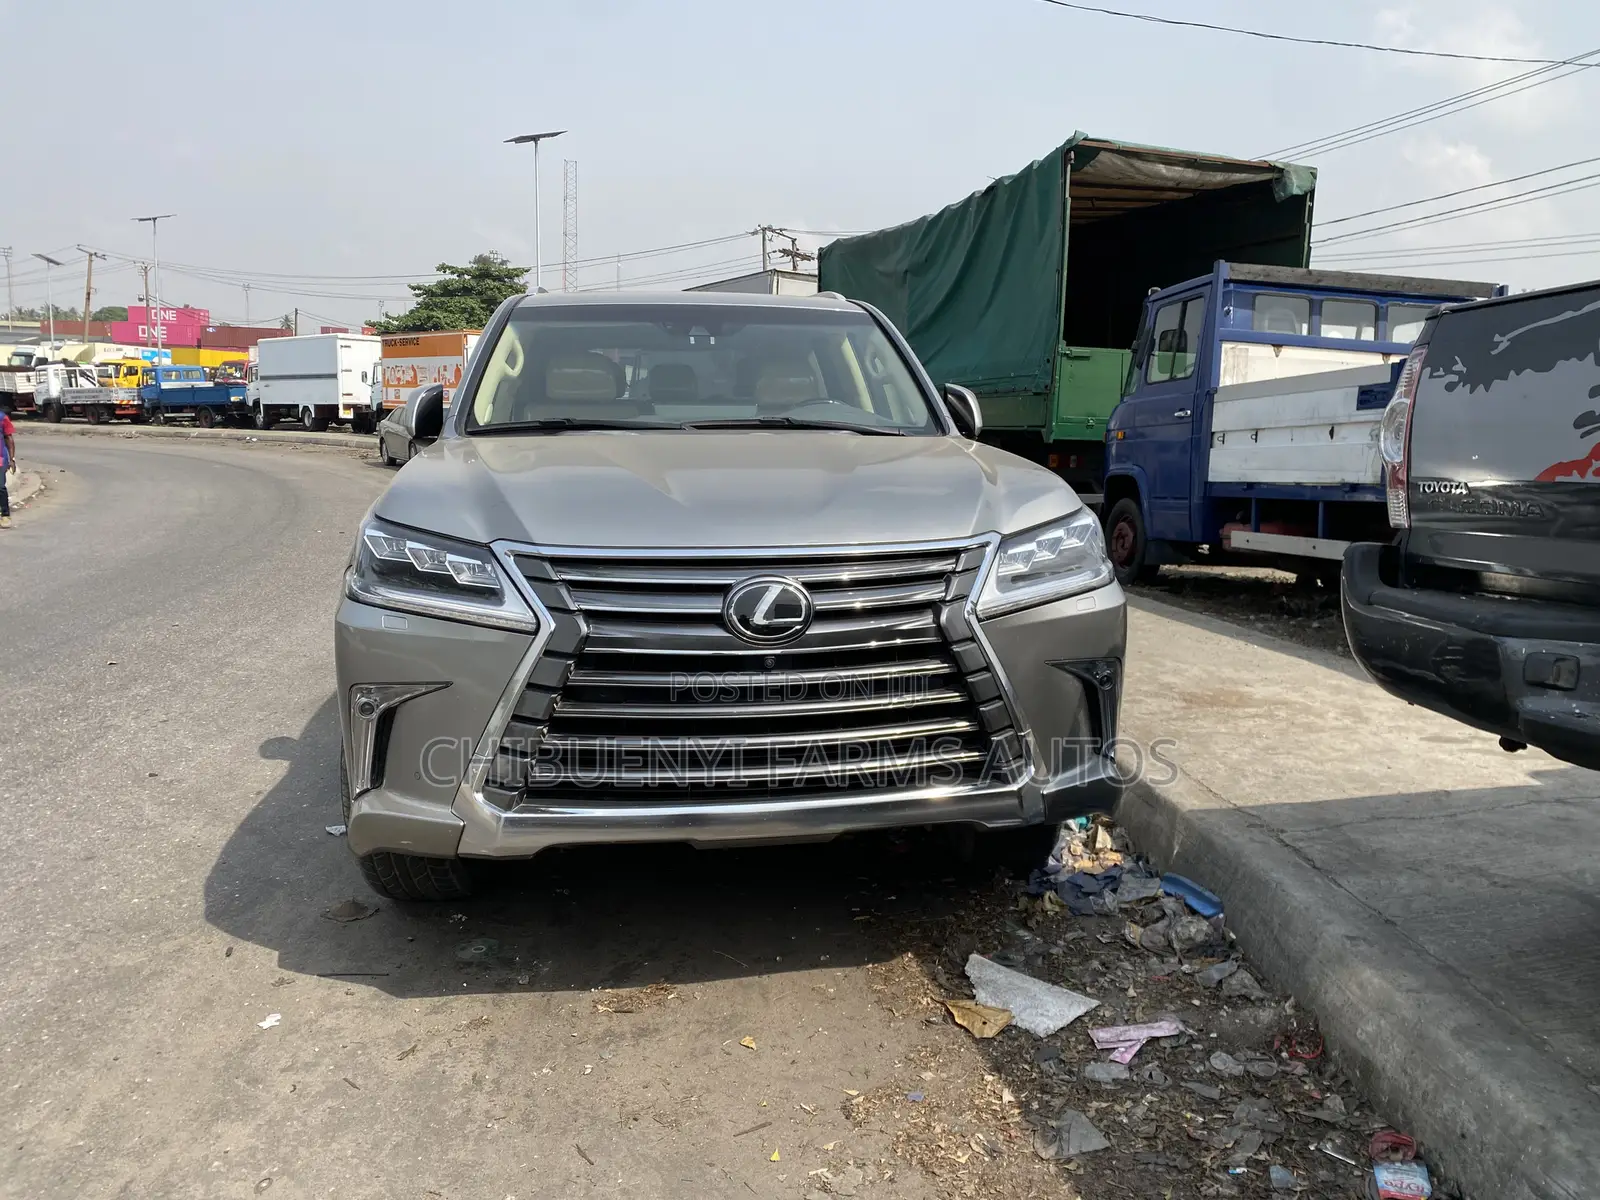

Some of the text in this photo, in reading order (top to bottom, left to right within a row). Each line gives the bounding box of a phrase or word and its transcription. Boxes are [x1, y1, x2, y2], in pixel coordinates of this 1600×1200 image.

[151, 309, 177, 321] ONE
[138, 325, 167, 338] ONE
[382, 337, 419, 347] TRUCK-SERVICE
[1418, 481, 1470, 495] TOYOTA
